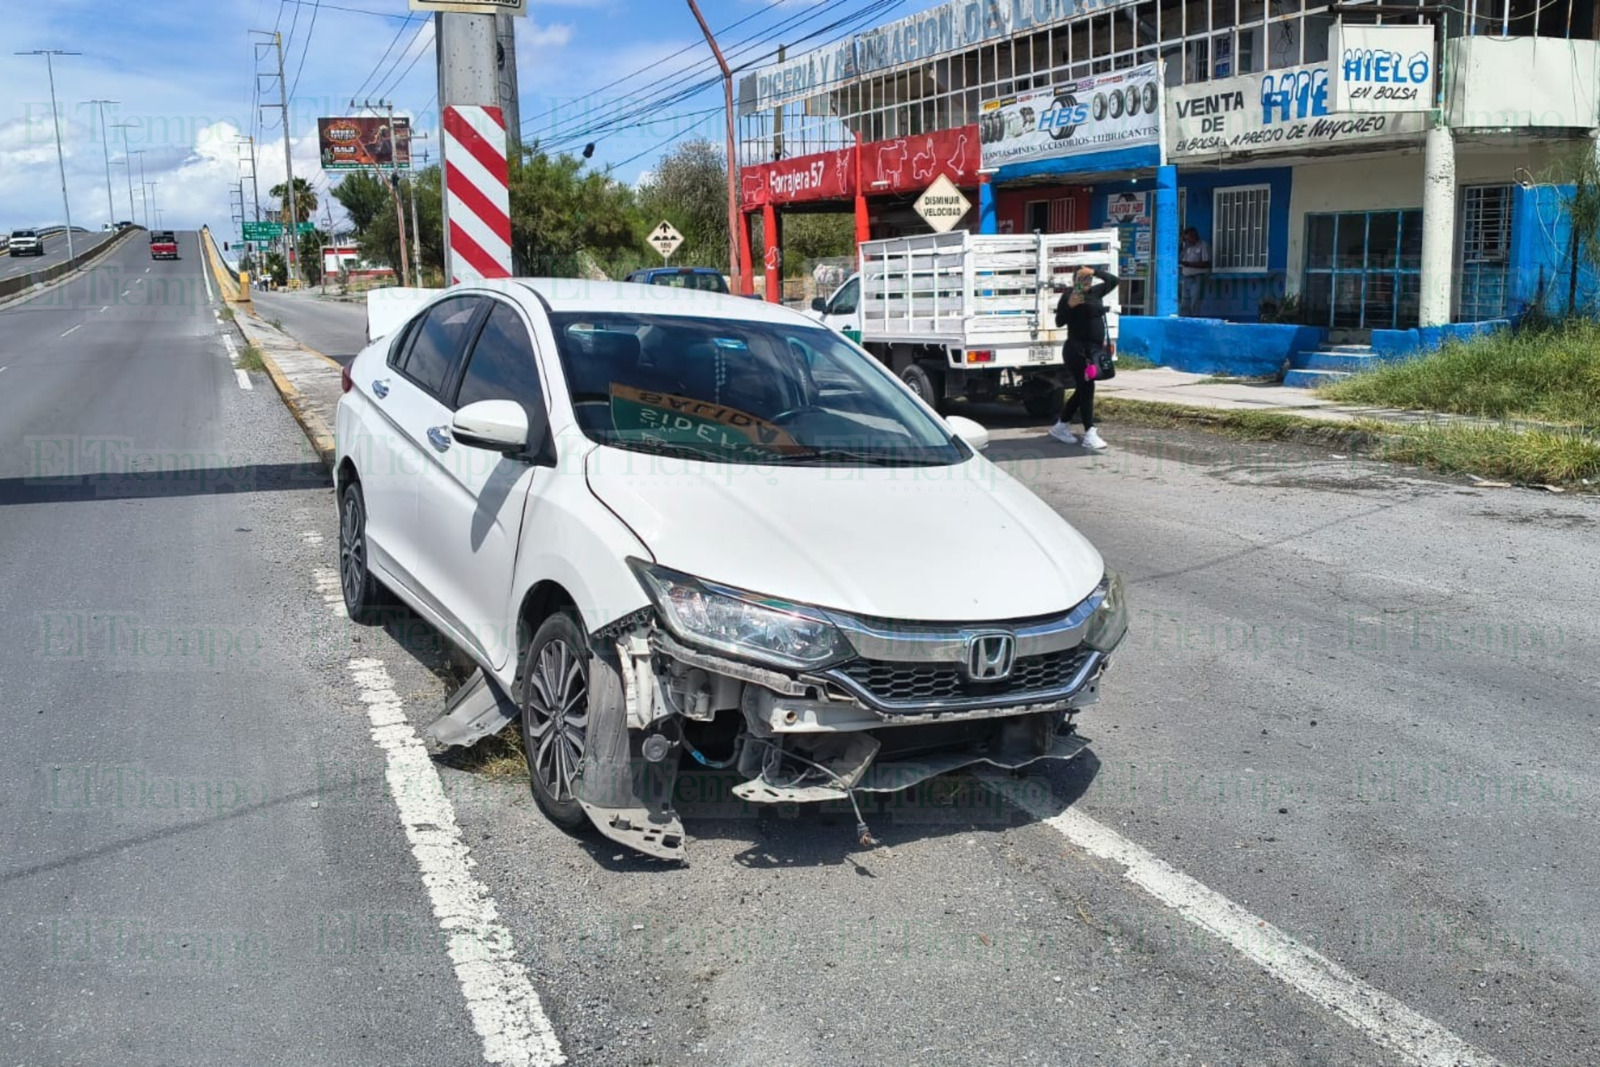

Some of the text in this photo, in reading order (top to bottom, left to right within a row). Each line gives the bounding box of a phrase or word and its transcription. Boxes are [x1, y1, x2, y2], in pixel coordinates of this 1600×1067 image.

[1342, 48, 1429, 84] HIELO
[1176, 91, 1244, 119] VENTA
[1350, 86, 1418, 100] EN BOLSA
[1038, 102, 1091, 131] HBS
[1201, 116, 1225, 133] DE
[1176, 115, 1386, 151] EN BOLSA A PRECIO DE MAYOREO
[770, 160, 824, 198] Forrajera 57
[923, 207, 961, 216] VELOCIDAD
[924, 196, 960, 205] DISMINUIR
